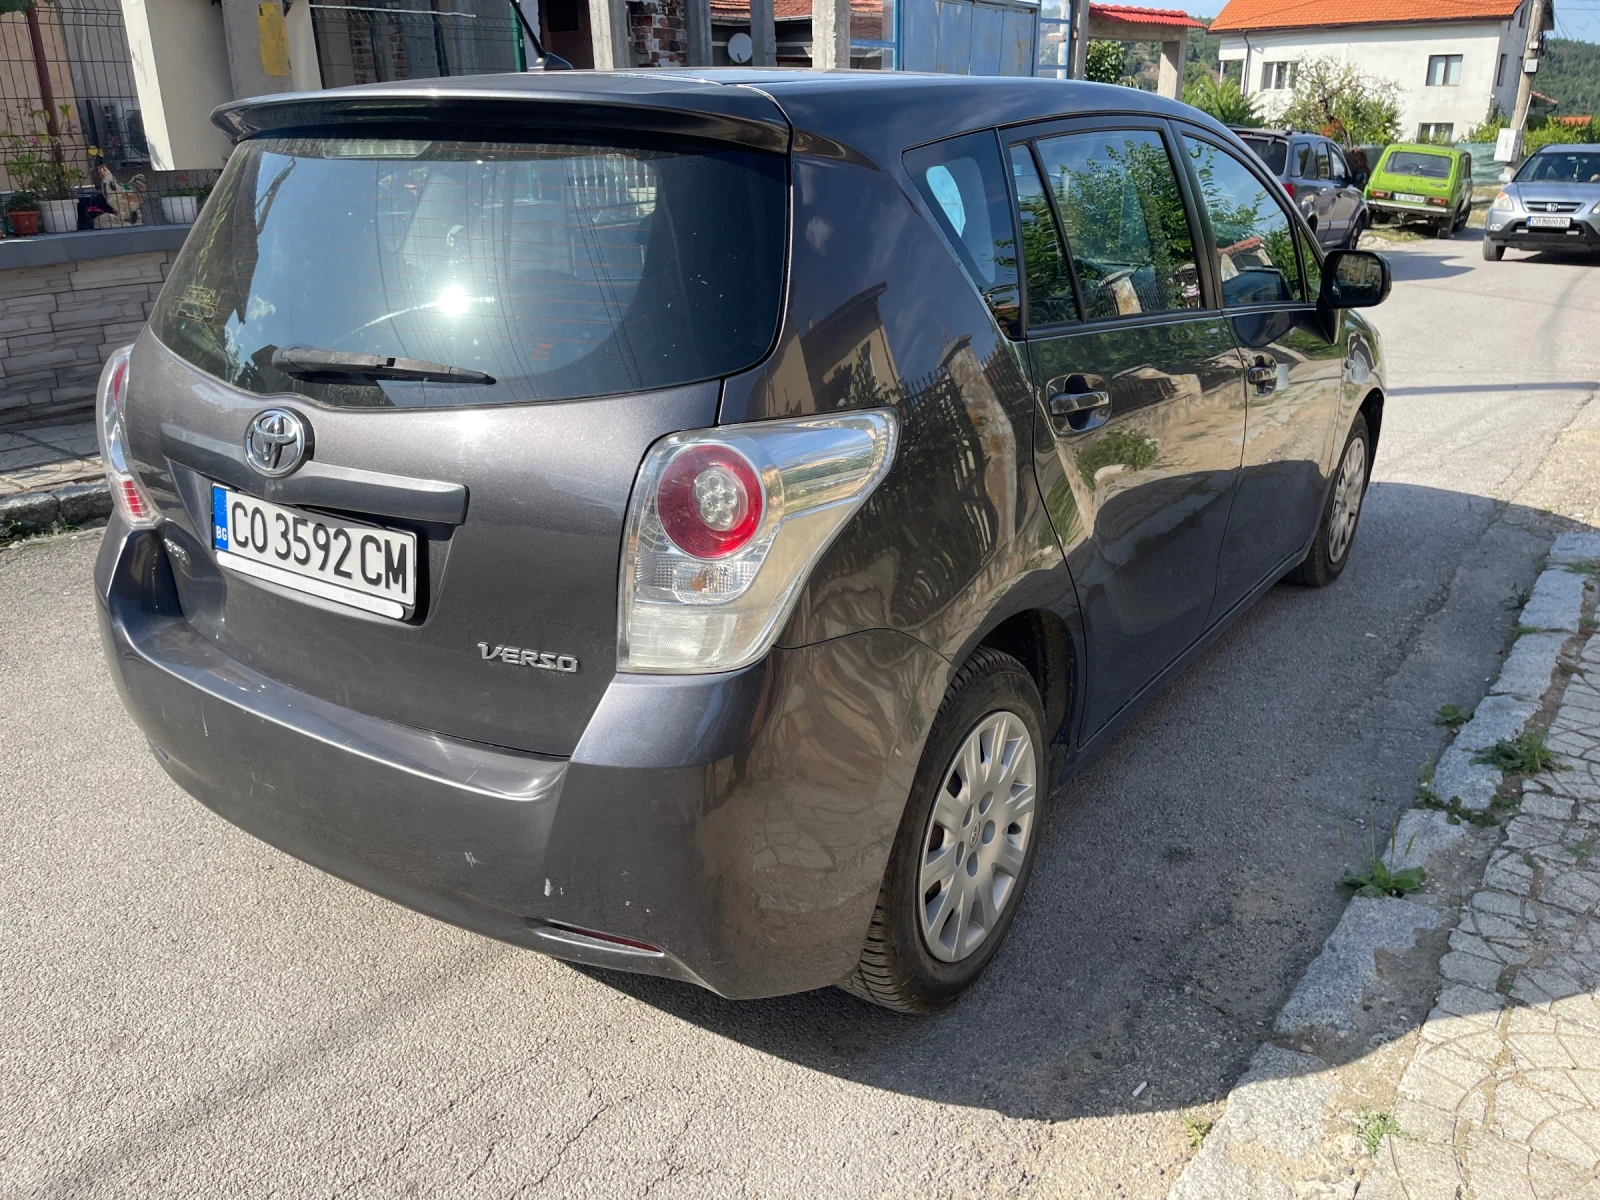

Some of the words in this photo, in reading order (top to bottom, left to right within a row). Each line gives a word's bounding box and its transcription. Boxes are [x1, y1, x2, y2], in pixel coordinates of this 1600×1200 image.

[216, 525, 228, 541] BG
[274, 512, 353, 579] 3592
[360, 534, 407, 594] CM
[477, 642, 578, 672] VERSO
